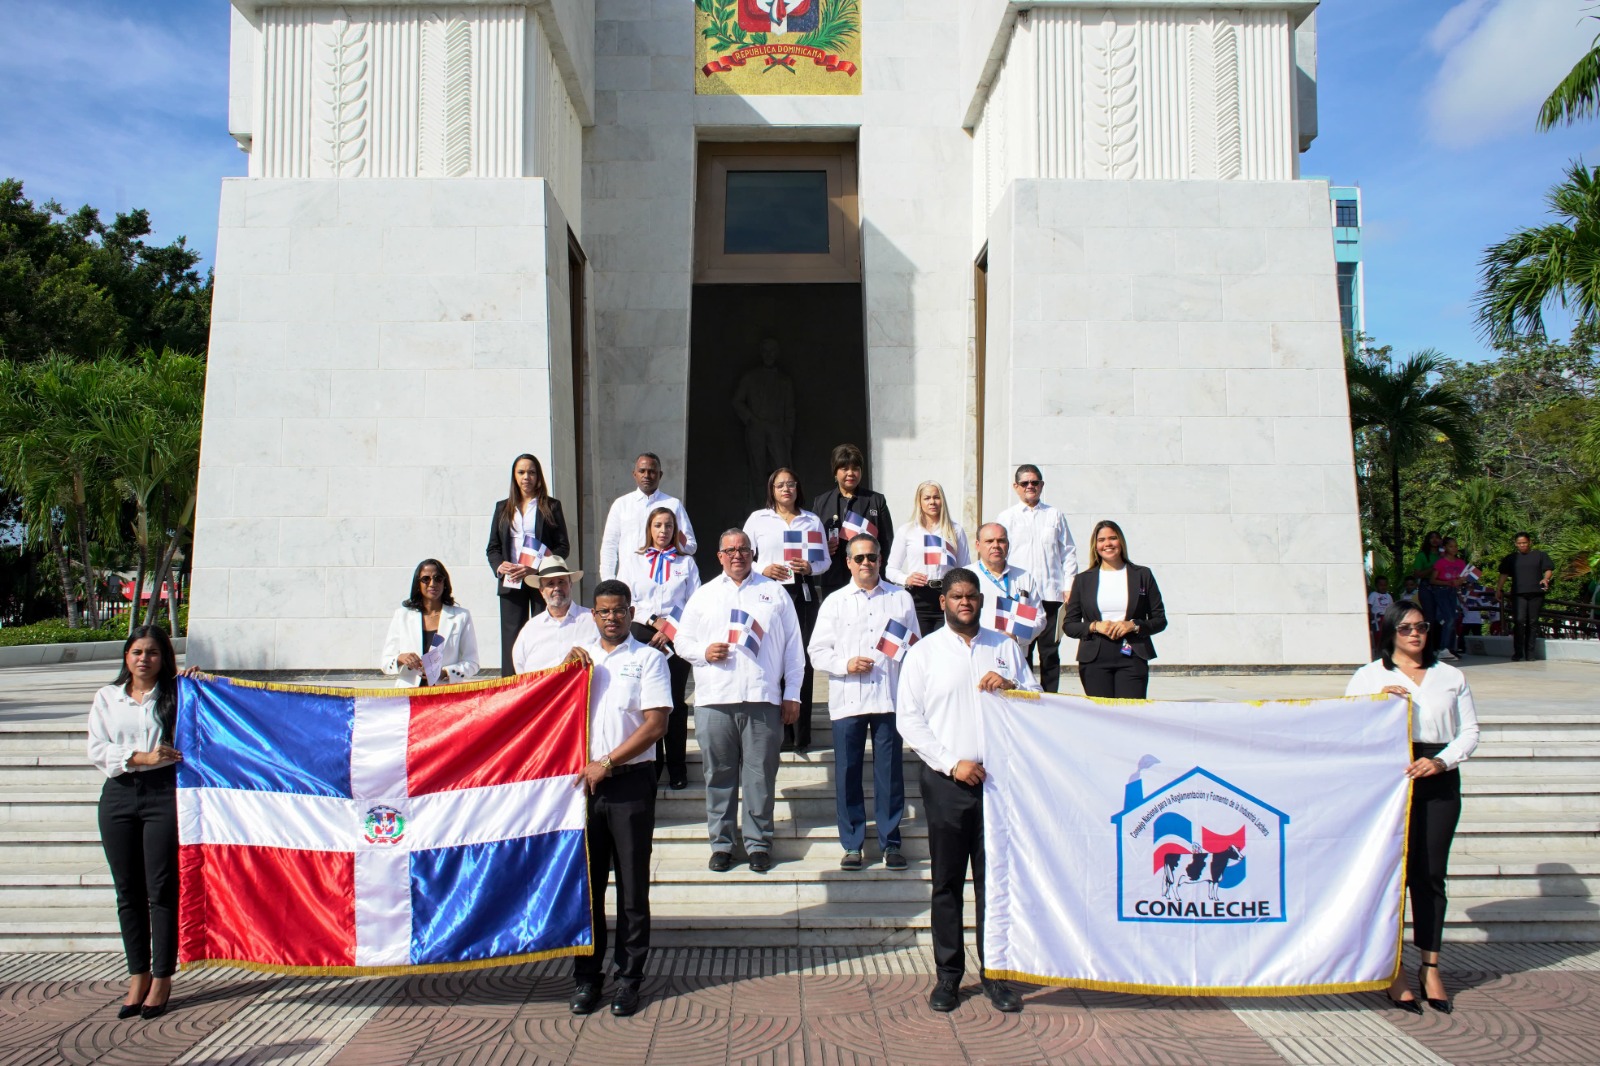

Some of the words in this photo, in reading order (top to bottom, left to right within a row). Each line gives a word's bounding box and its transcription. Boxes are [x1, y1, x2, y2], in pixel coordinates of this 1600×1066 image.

[735, 46, 776, 60] REPUBLICA
[777, 45, 822, 58] DOMINICANA
[1130, 821, 1146, 838] Consejo
[1141, 804, 1159, 824] Nacional
[1157, 800, 1168, 812] para
[1165, 796, 1172, 805] la
[1170, 790, 1205, 804] Reglamentación
[1205, 792, 1210, 802] y
[1210, 791, 1229, 805] Fomento
[1228, 799, 1236, 808] de
[1234, 801, 1240, 811] la
[1239, 804, 1257, 823] Industria
[1254, 818, 1270, 837] Lechera
[1135, 900, 1270, 917] CONALECHE
